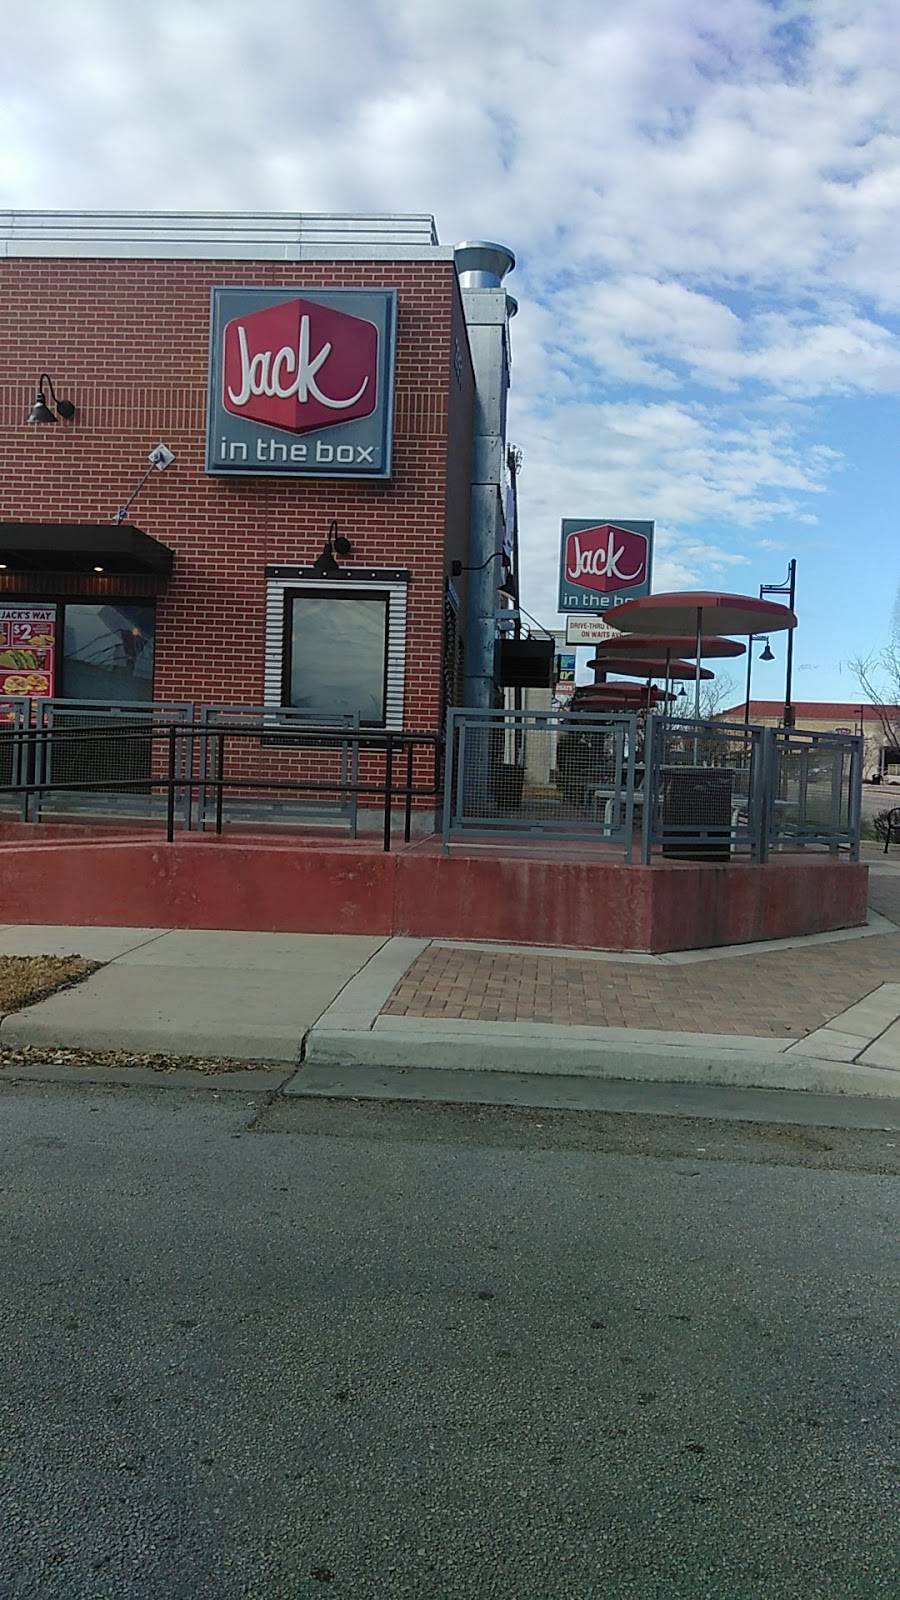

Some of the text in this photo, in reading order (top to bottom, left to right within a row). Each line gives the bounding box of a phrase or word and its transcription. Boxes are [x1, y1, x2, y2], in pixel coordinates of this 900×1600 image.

[228, 315, 368, 409] Jack
[220, 436, 374, 463] in the box
[568, 532, 643, 580] Jack
[563, 593, 578, 605] in
[582, 595, 610, 606] the
[1, 611, 51, 620] JACK'S WAY
[14, 623, 32, 640] $2
[570, 622, 605, 630] DRIVE-THRU
[581, 630, 590, 638] ON
